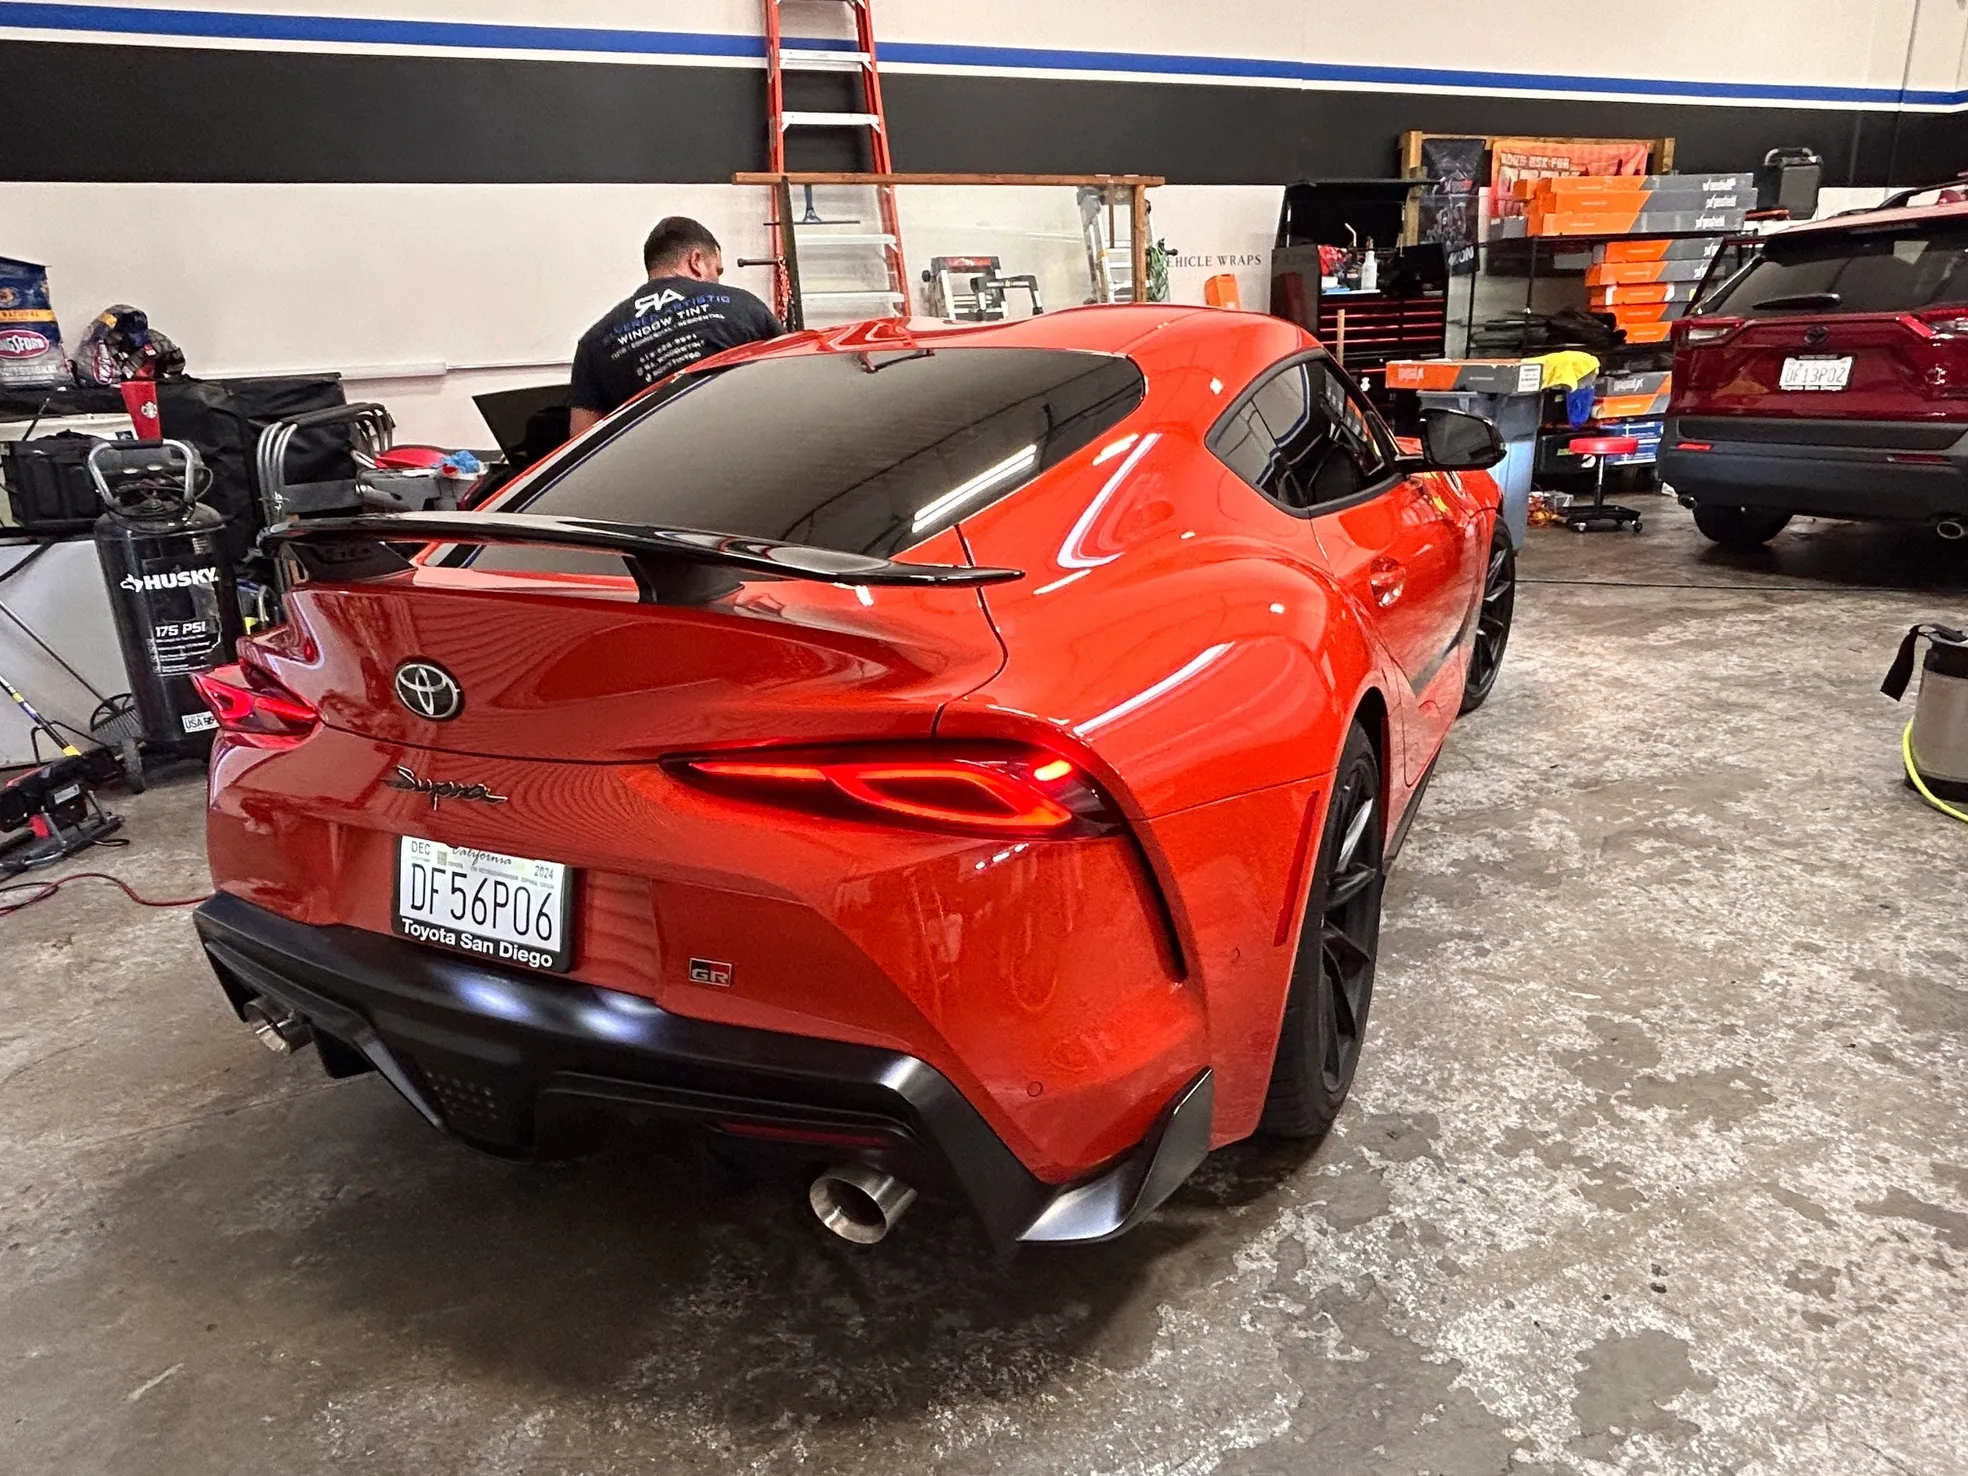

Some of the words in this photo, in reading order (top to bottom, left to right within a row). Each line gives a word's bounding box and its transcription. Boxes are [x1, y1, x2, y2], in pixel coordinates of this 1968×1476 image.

[1166, 255, 1213, 268] EHICLE
[1217, 254, 1262, 267] WRAPS
[617, 316, 672, 345] WINDOW
[676, 303, 710, 319] TINT
[155, 624, 179, 637] 175
[182, 621, 206, 635] PSI
[185, 719, 203, 729] USA
[411, 841, 431, 856] DEC
[534, 865, 554, 880] 2024
[411, 863, 552, 941] DF56P06
[402, 918, 456, 945] Toyota
[460, 933, 494, 955] San
[499, 941, 553, 968] Diego
[692, 968, 729, 983] GR
